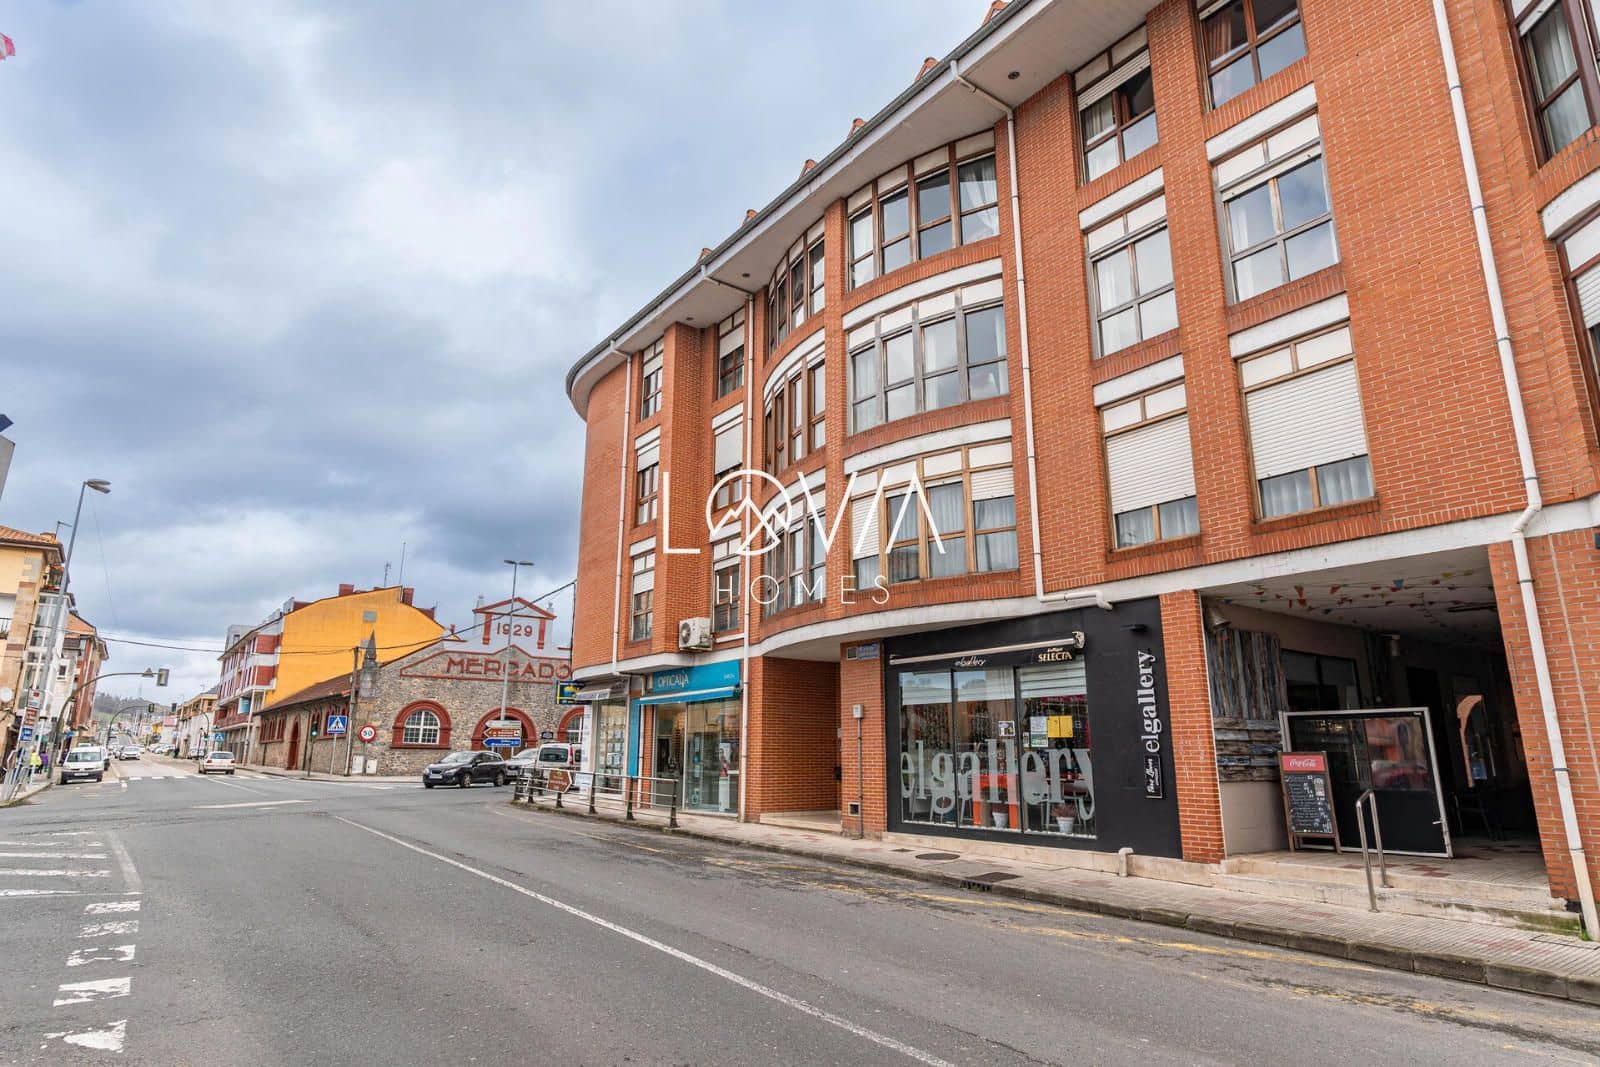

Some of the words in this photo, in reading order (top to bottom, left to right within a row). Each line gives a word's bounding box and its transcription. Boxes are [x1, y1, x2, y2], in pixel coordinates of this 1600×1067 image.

[496, 622, 533, 637] 1929
[446, 657, 572, 680] MERCADO
[1038, 651, 1073, 663] SELECTA
[1137, 650, 1163, 753] elgallery
[900, 738, 1096, 821] elgallery
